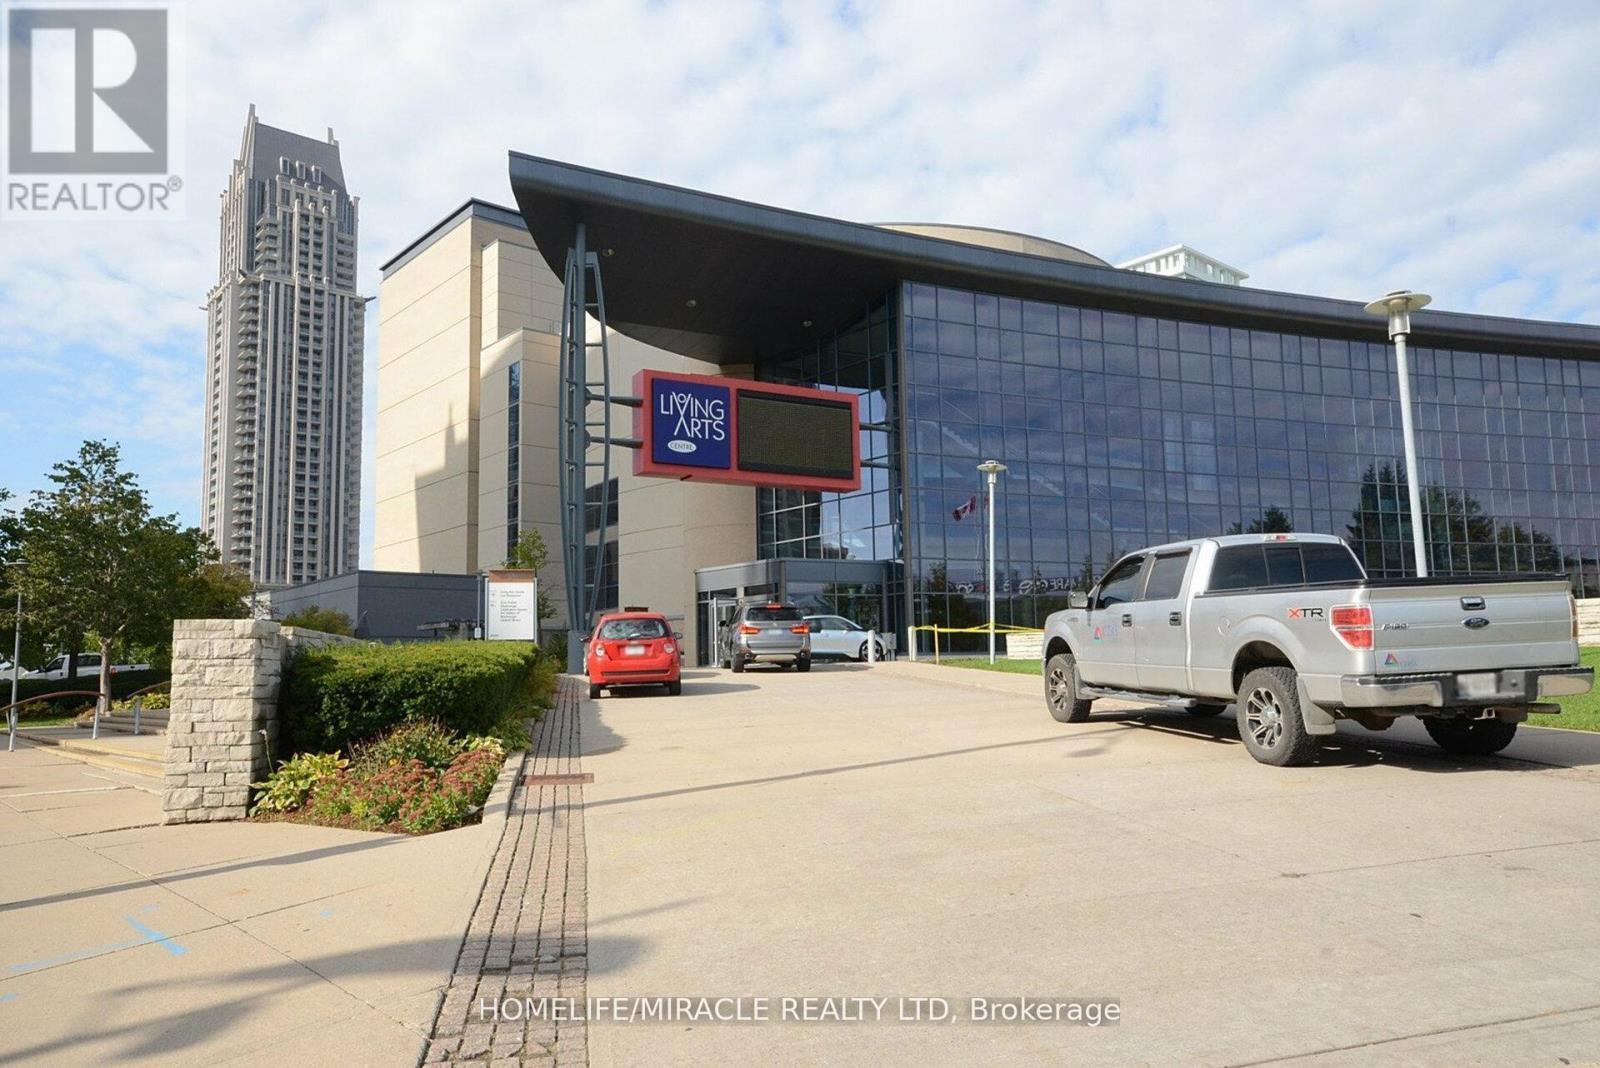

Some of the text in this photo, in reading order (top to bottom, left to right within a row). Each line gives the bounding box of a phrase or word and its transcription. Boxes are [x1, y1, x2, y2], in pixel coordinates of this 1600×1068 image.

[660, 391, 725, 420] LIVING
[673, 415, 725, 441] ARTS
[1289, 607, 1324, 618] XTR
